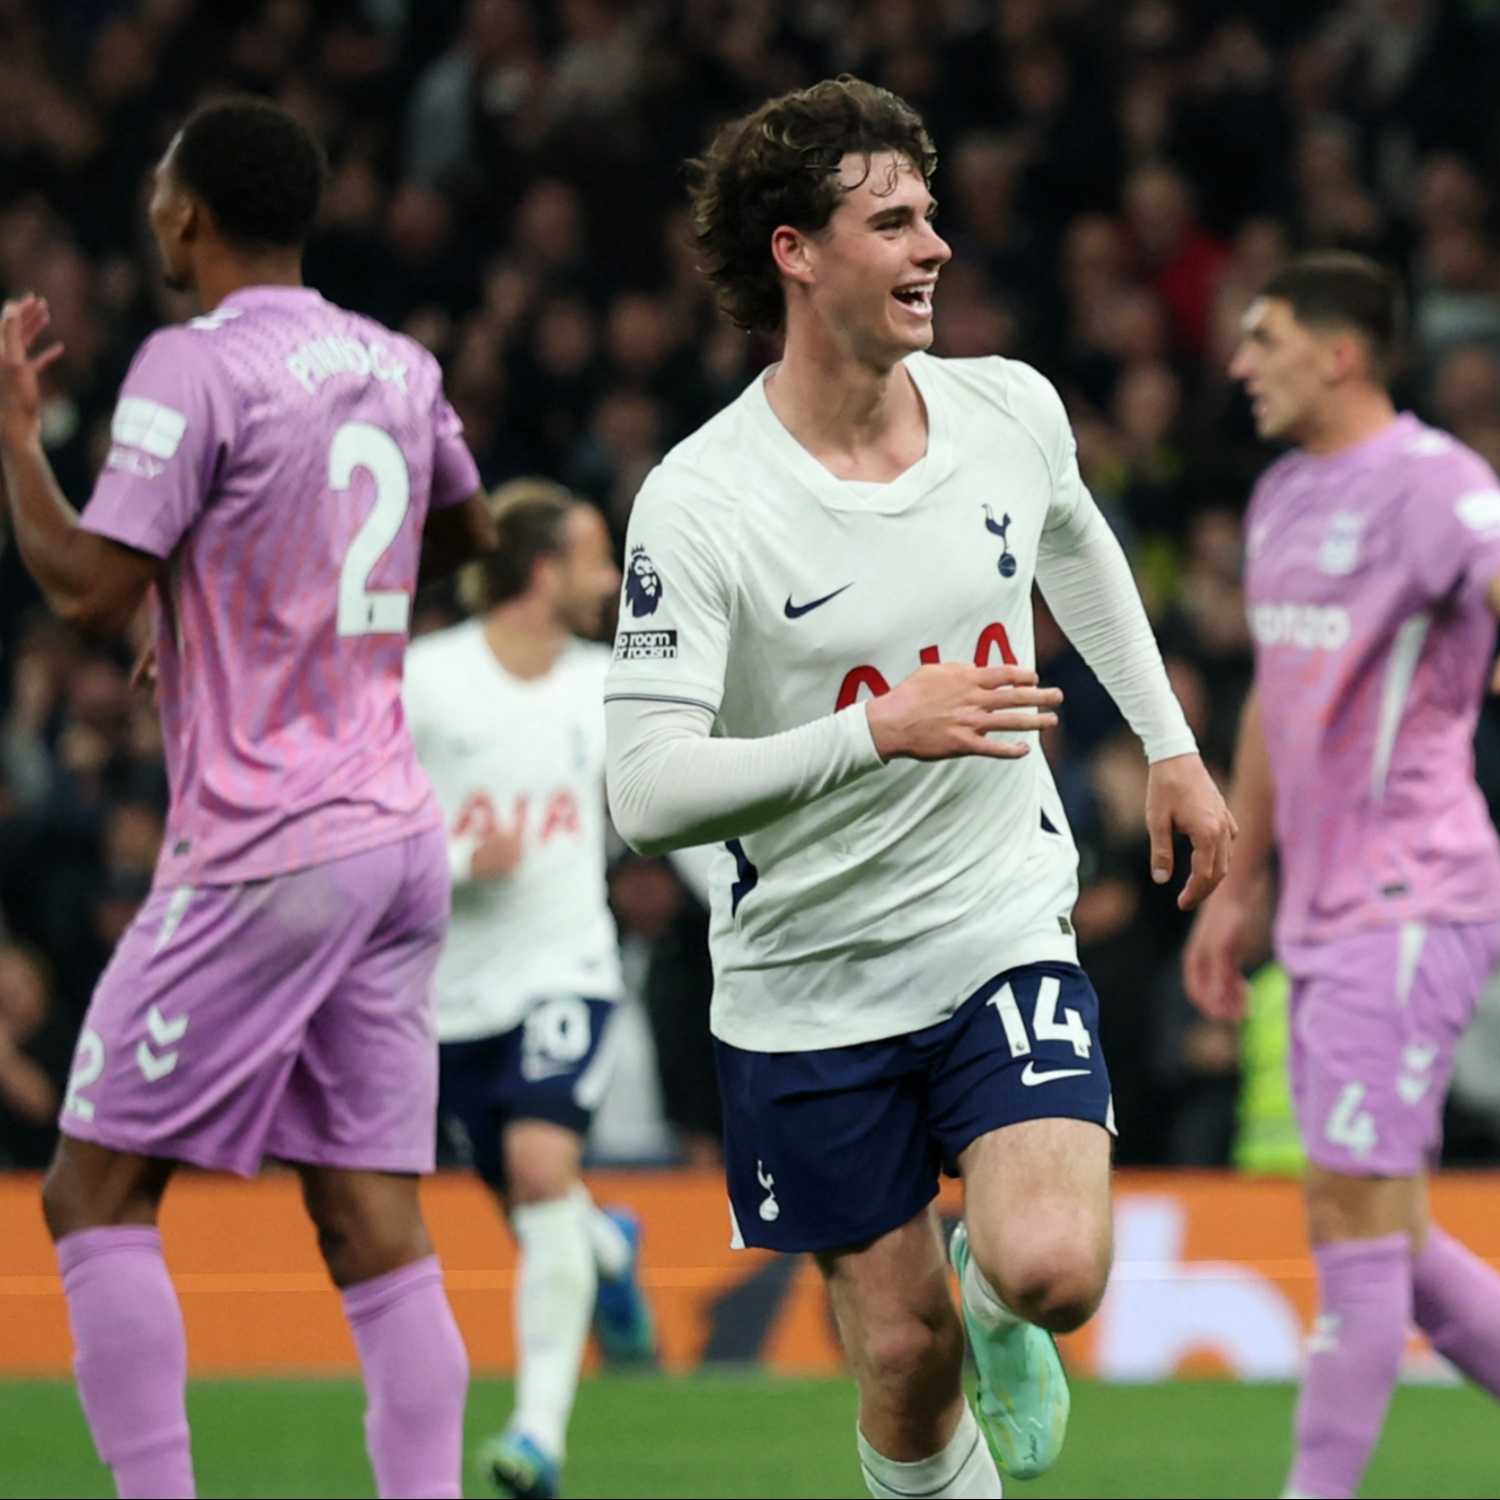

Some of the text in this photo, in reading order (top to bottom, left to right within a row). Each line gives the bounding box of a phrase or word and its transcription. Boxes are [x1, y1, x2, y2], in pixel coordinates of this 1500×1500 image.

[328, 422, 410, 637] 2
[629, 632, 671, 647] room
[987, 976, 1092, 1059] 14
[1323, 1081, 1378, 1159] 4
